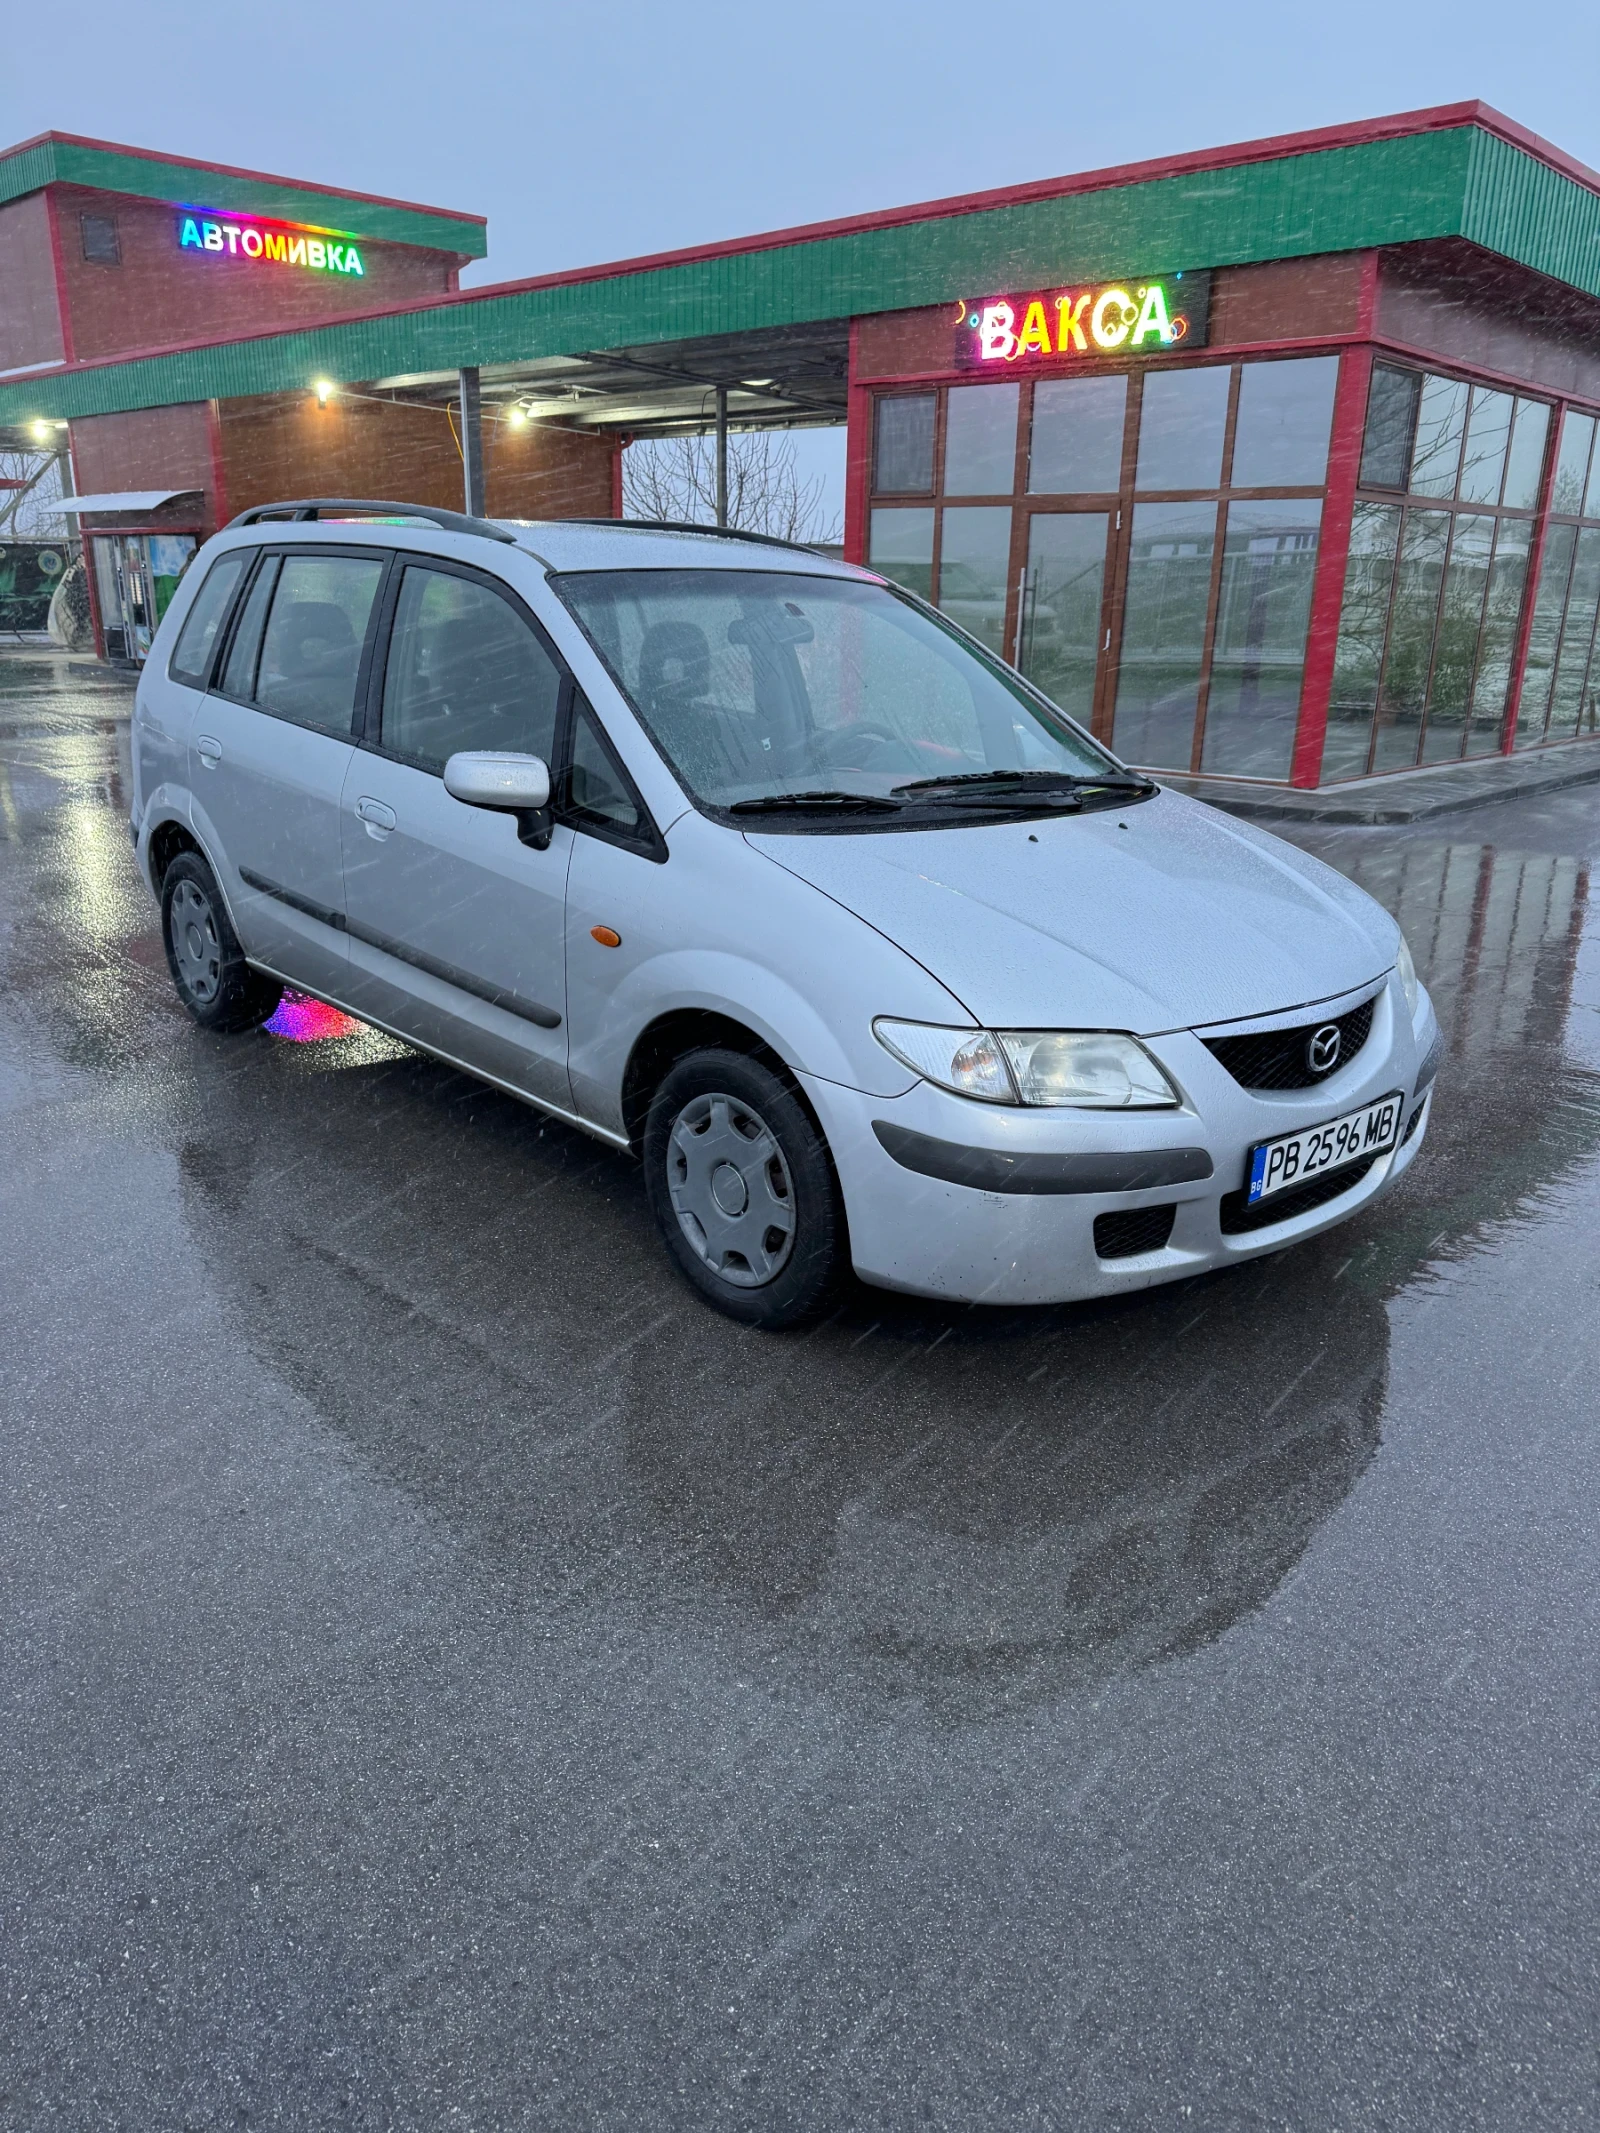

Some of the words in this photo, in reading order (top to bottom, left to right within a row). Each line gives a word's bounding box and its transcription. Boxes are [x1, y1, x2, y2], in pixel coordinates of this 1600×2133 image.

[181, 219, 364, 275] АВТОМИВКА
[981, 286, 1172, 360] ВАКСА
[1266, 1141, 1300, 1188] PB
[1303, 1117, 1361, 1173] 2596
[1363, 1104, 1394, 1148] MB
[1251, 1179, 1262, 1194] BG
